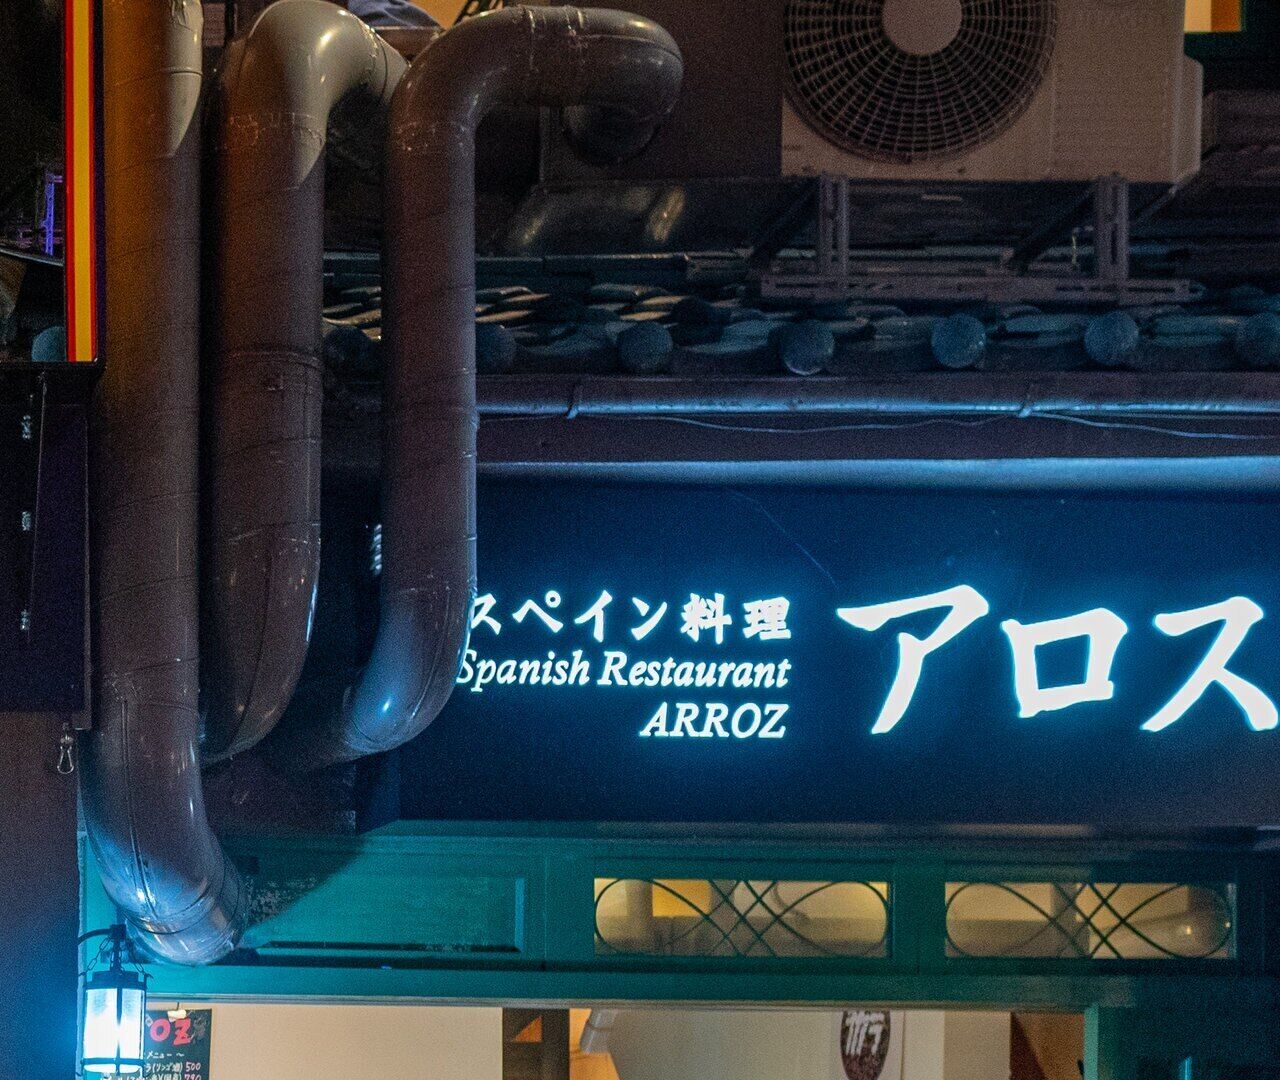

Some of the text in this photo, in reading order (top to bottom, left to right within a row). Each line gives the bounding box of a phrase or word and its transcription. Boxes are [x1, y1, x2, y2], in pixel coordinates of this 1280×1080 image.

[471, 589, 792, 643] スペイン料理
[456, 649, 789, 693] Spanish Restaurant
[836, 584, 1279, 735] アロス
[640, 702, 788, 739] ARROZ
[185, 1061, 201, 1072] 500
